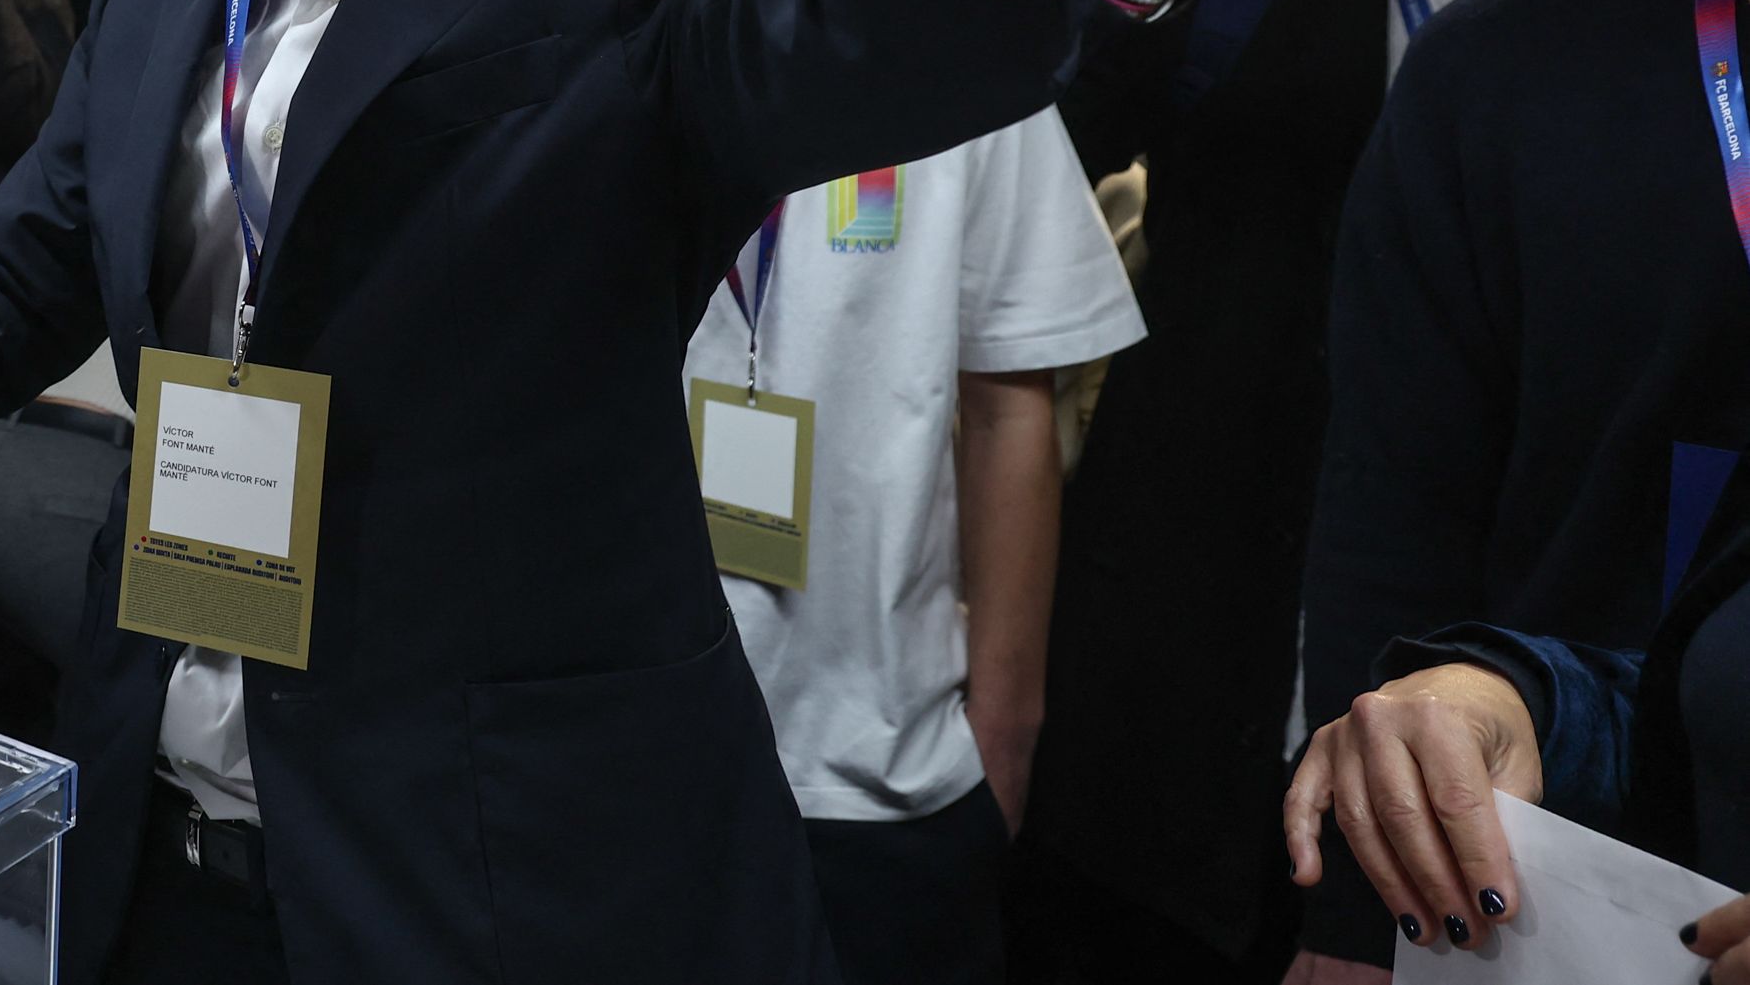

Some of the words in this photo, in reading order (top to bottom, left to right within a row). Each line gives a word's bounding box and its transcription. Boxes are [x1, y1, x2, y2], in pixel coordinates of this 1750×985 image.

[1714, 78, 1727, 94] FC
[1717, 93, 1742, 161] BARCELONA
[162, 425, 194, 439] VÍCTOR
[161, 438, 185, 450] FONT
[185, 442, 215, 455] MANTÉ
[159, 468, 189, 482] MANTÉ
[160, 460, 219, 479] CANDIDATURA
[221, 470, 253, 485] VÍCTOR
[253, 477, 278, 489] FONT
